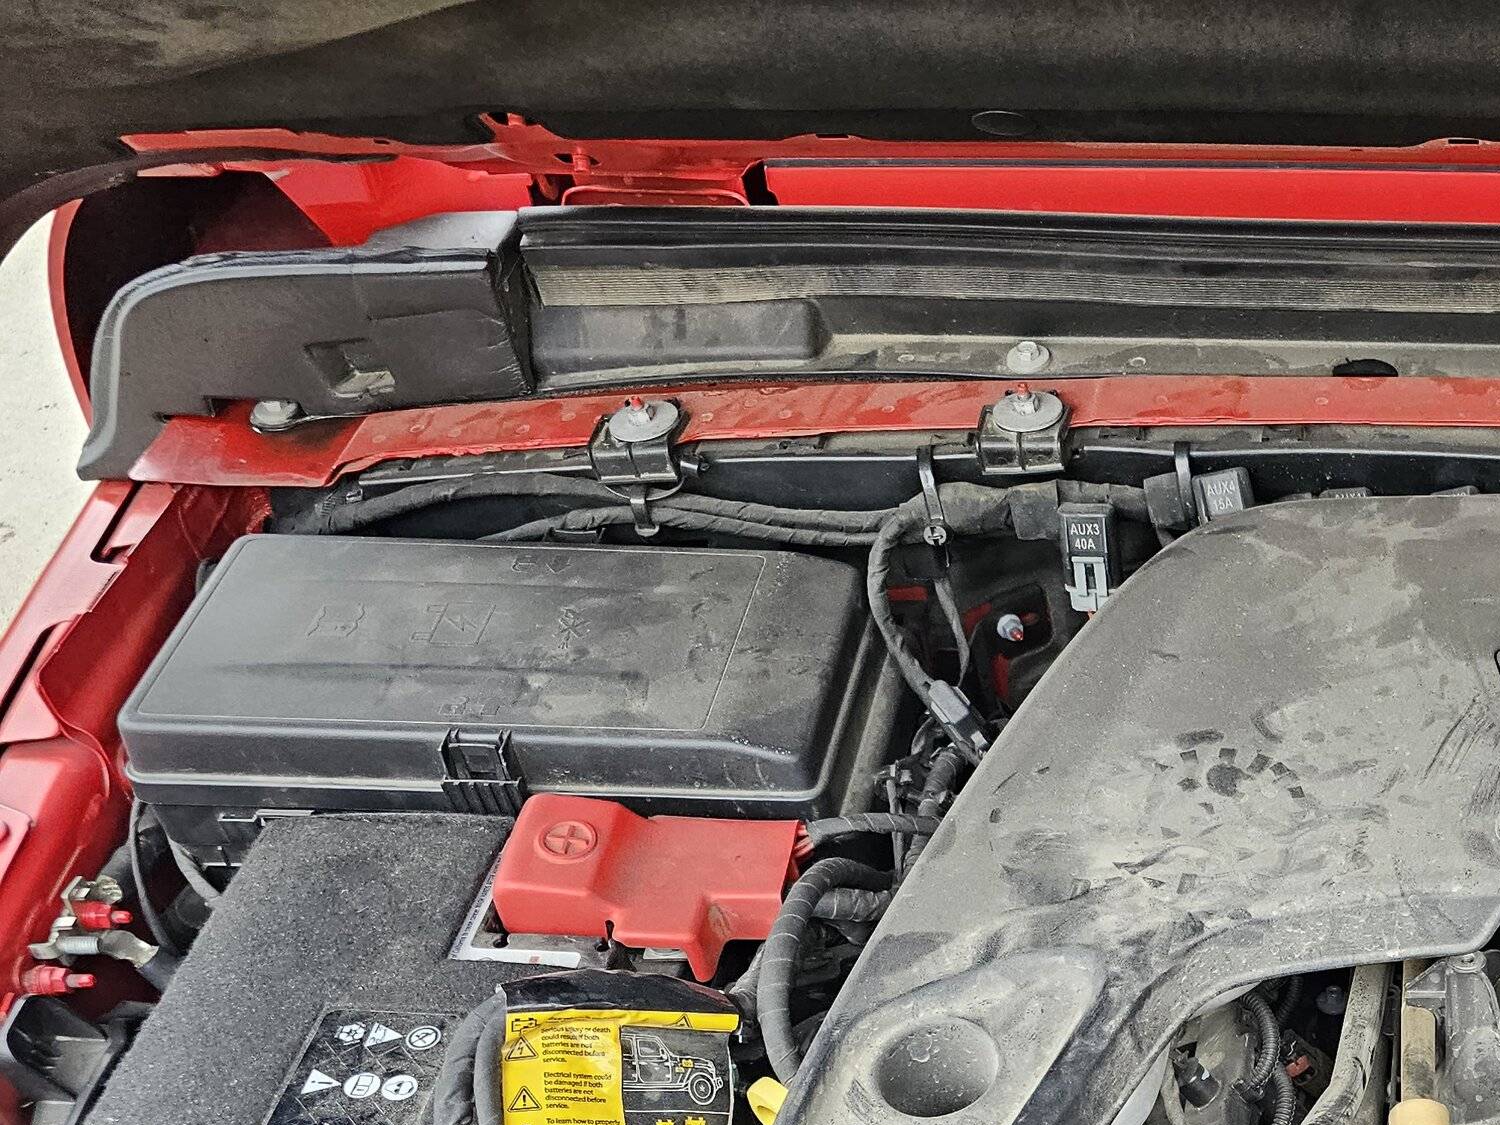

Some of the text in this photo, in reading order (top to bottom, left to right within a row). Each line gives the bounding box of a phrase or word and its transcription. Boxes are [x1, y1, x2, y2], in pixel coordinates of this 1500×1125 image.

[1207, 480, 1236, 496] AUX4
[1213, 496, 1234, 510] 15A
[1070, 523, 1100, 535] AUX3
[1075, 538, 1096, 550] 40A
[553, 1079, 583, 1087] damaged
[545, 1094, 607, 1103] disconnected before
